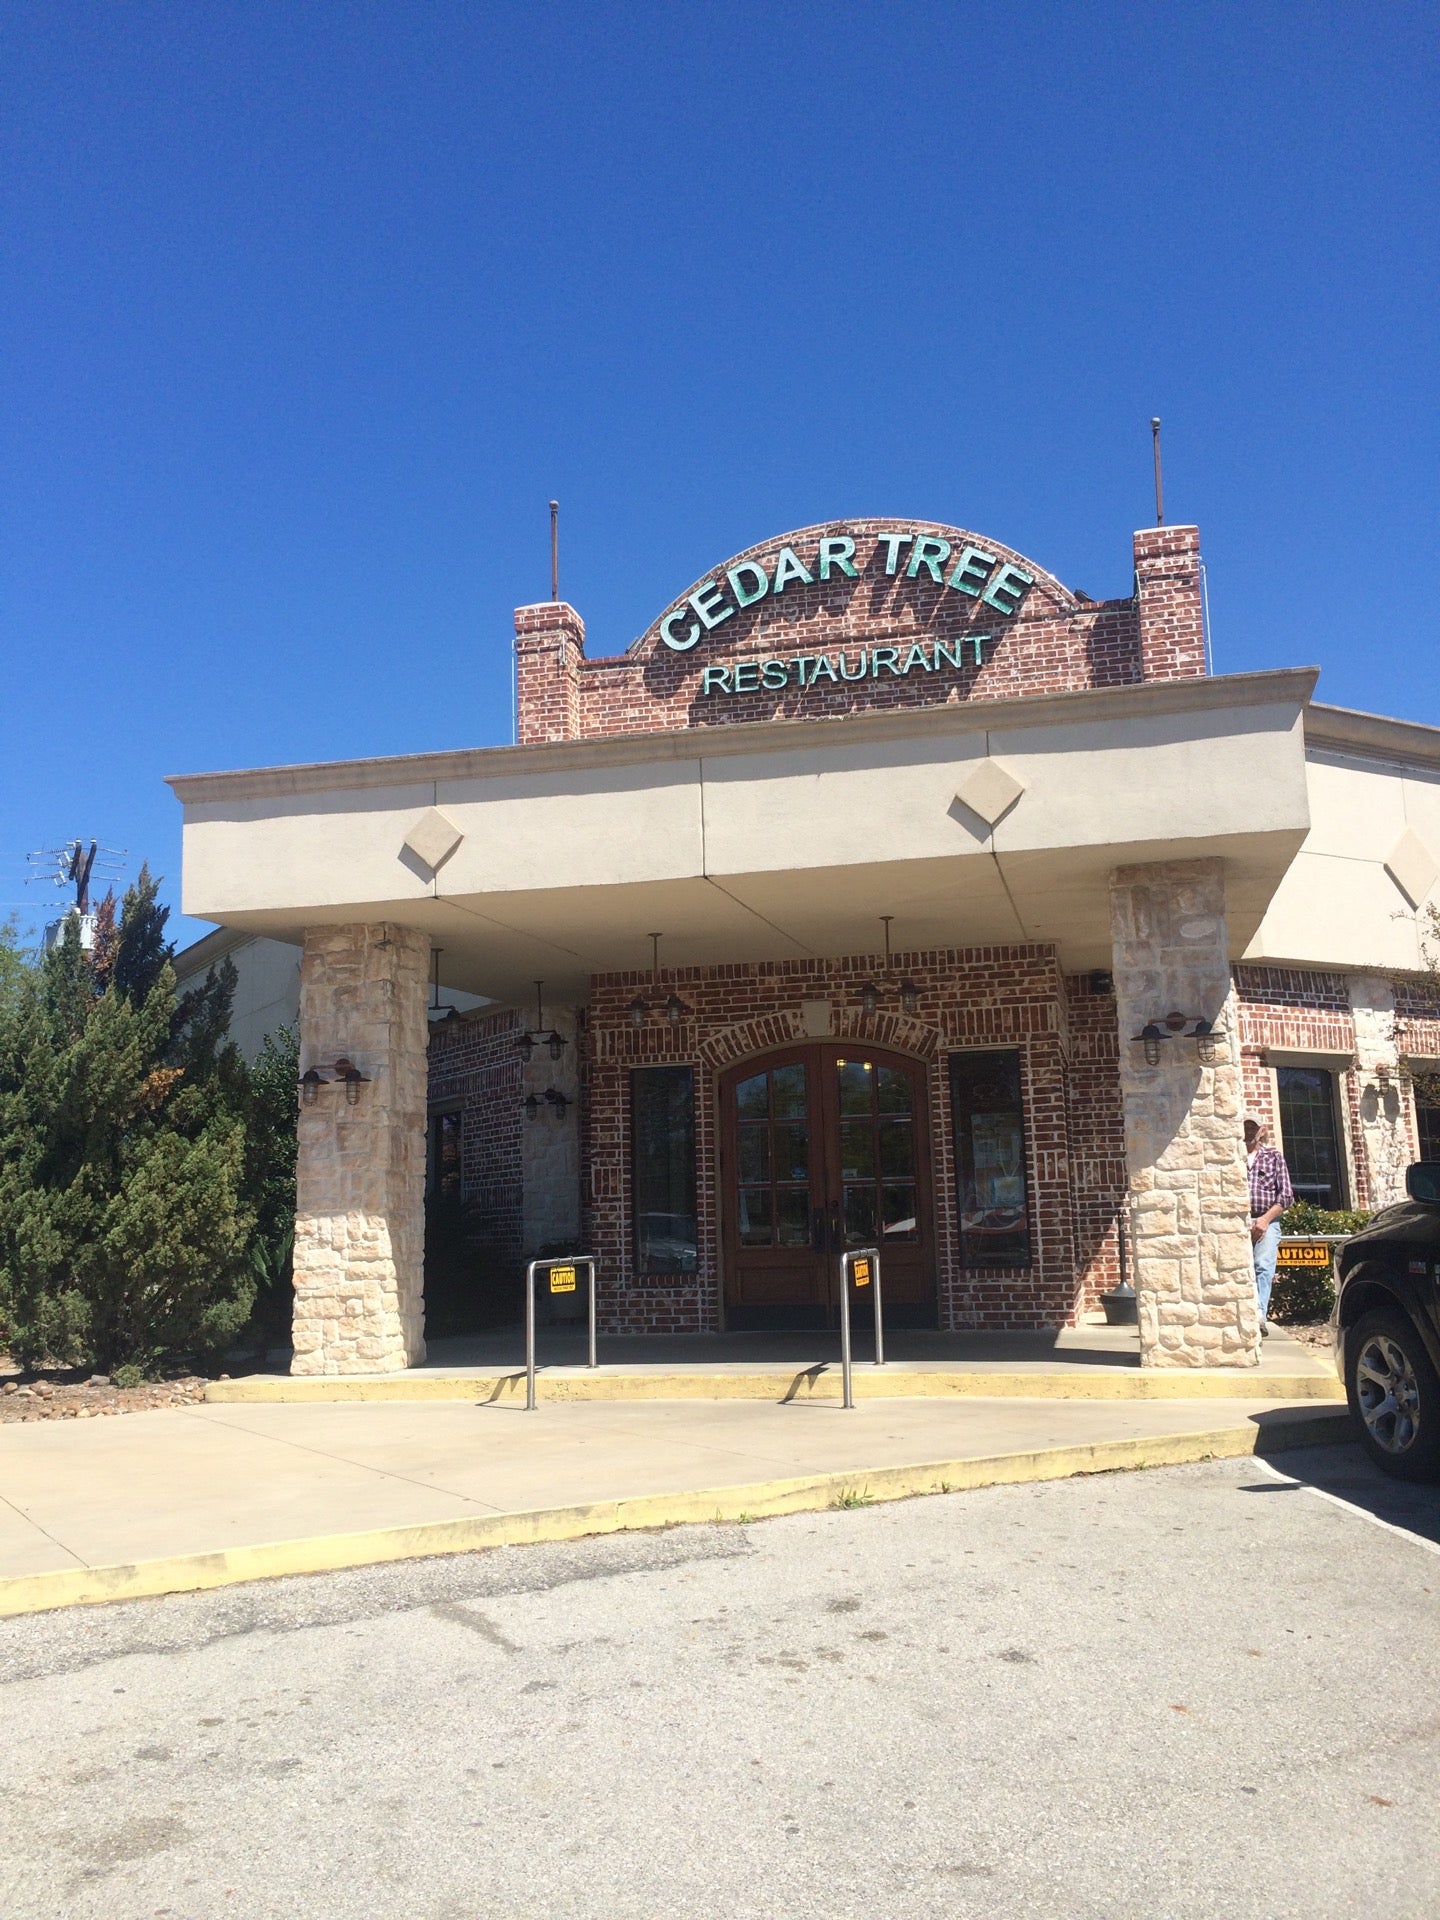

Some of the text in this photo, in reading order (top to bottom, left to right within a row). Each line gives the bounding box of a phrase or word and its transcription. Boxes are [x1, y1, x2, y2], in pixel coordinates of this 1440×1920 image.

[659, 533, 1034, 651] CEDAR TREE
[703, 635, 992, 695] RESTAURANT
[1277, 1248, 1325, 1259] UTION
